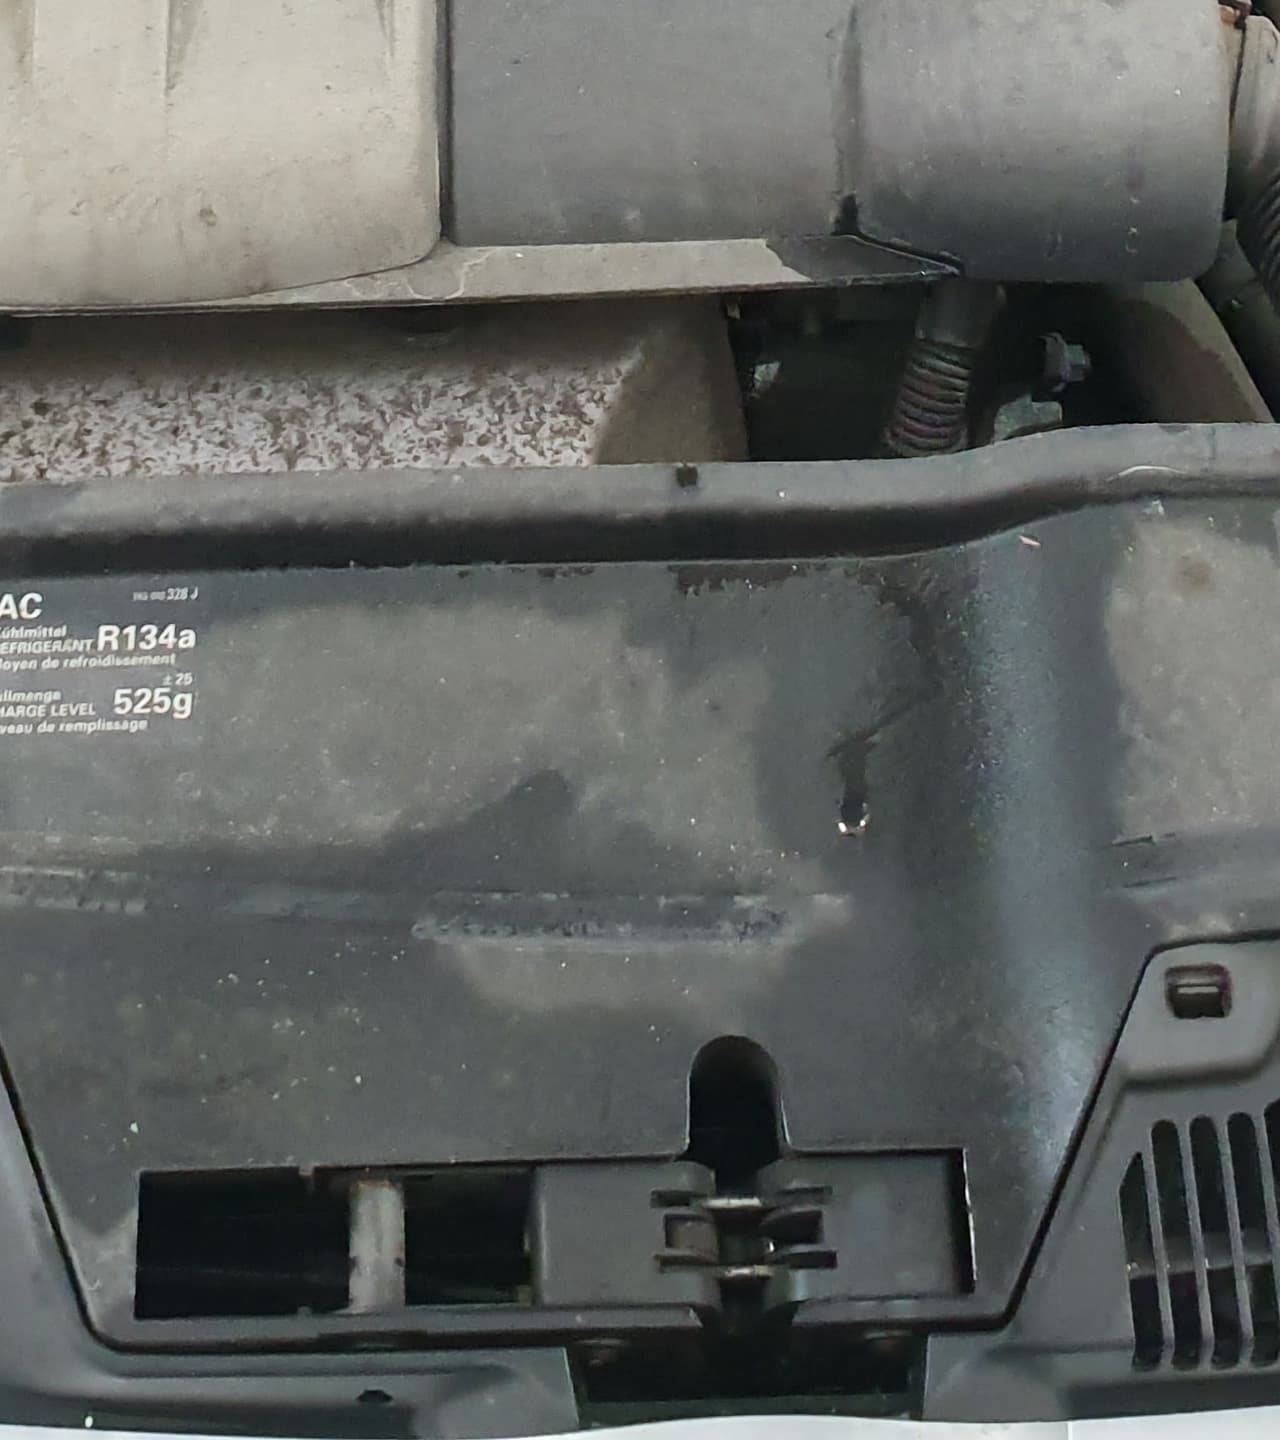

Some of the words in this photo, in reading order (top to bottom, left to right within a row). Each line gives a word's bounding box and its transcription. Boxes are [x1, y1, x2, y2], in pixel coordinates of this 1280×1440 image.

[97, 623, 196, 651] R134a
[41, 656, 60, 669] de
[63, 653, 176, 668] refroidissement
[175, 672, 193, 685] 25
[51, 702, 96, 717] LEVEL
[114, 687, 193, 719] 525g
[37, 720, 56, 733] de
[59, 718, 148, 735] remplissage
